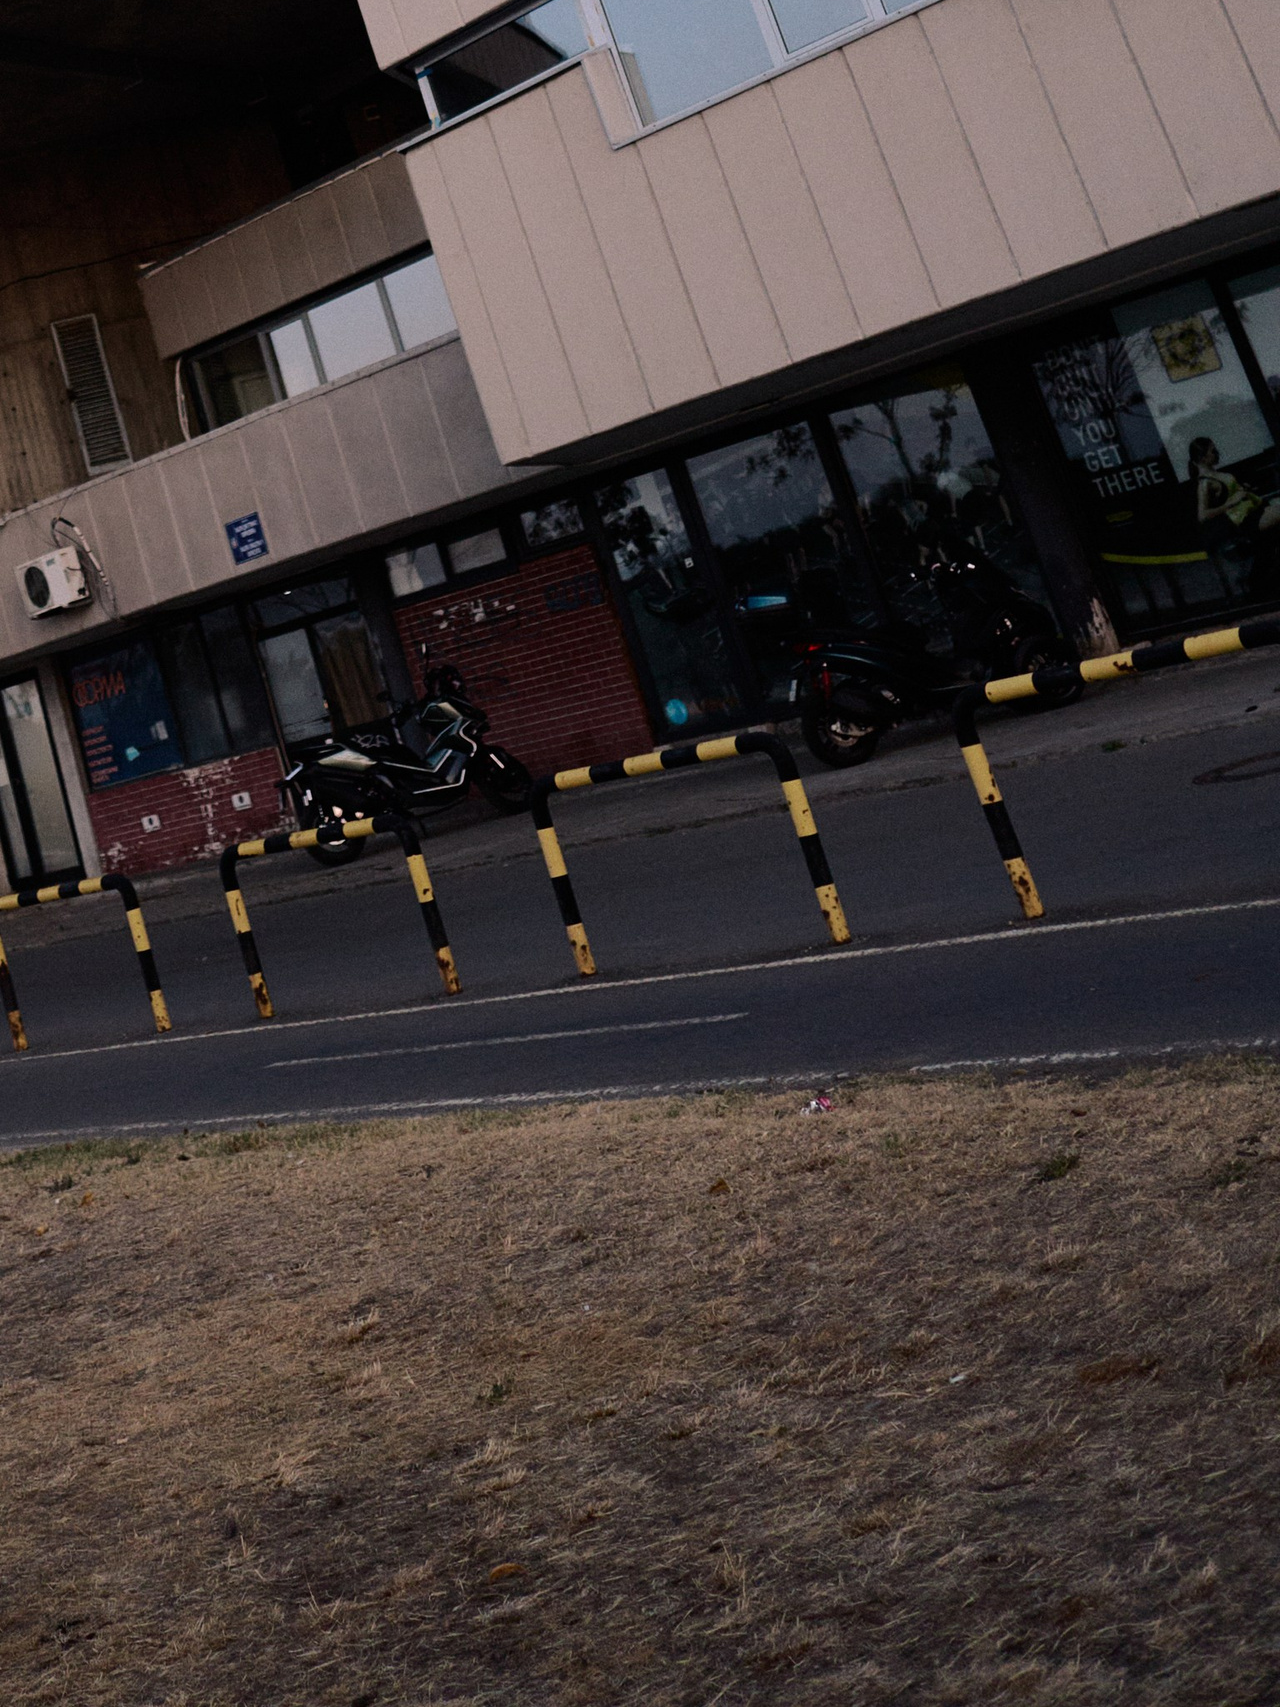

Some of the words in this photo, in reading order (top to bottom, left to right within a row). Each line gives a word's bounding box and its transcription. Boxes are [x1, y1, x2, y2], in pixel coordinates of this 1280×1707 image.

[1071, 417, 1116, 446] YOU
[1083, 443, 1123, 472] GET
[1091, 461, 1165, 498] THERE
